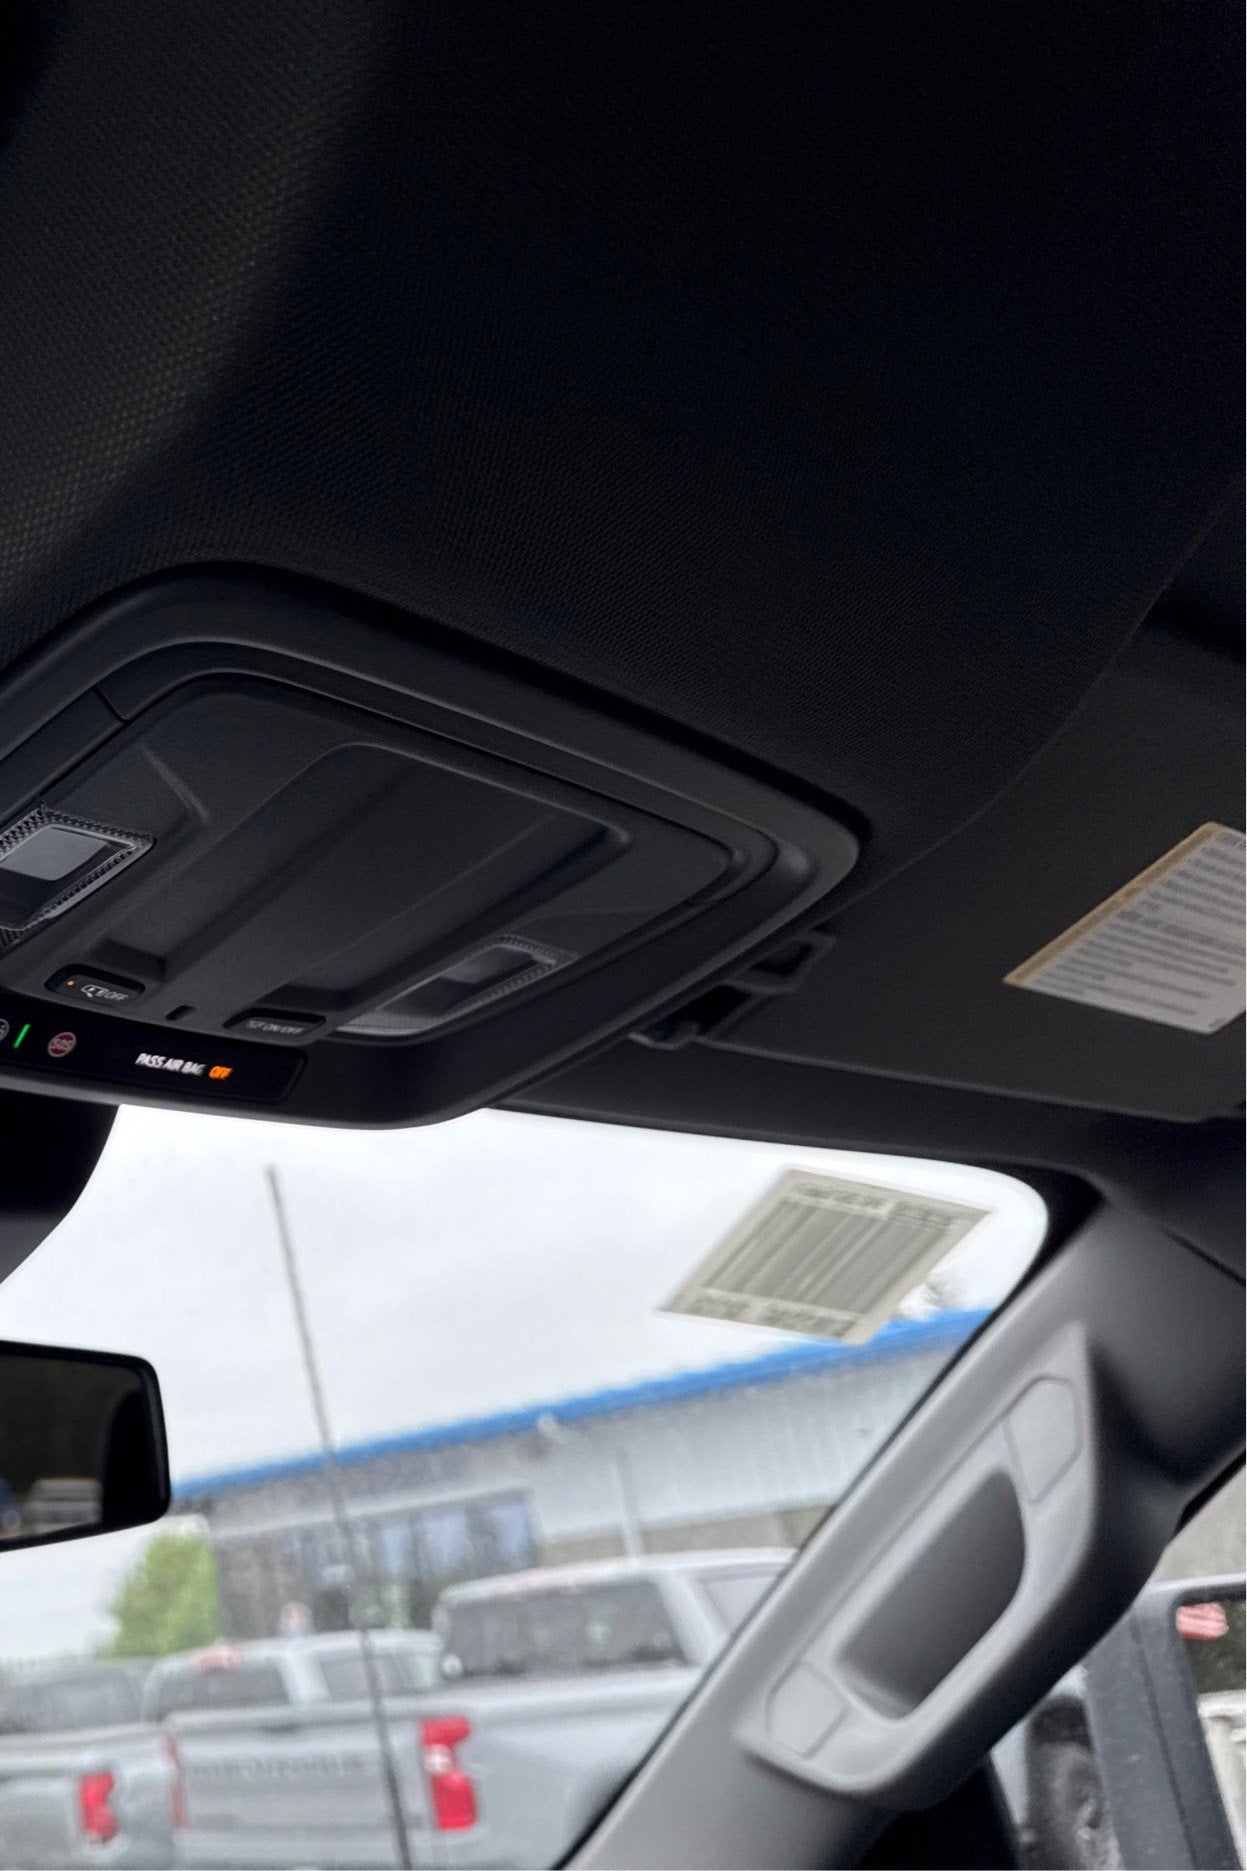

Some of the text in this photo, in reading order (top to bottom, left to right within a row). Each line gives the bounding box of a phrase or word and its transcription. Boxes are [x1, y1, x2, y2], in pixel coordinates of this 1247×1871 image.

[104, 991, 129, 1001] OFF
[135, 1052, 234, 1080] PASS AIR BAG OFF
